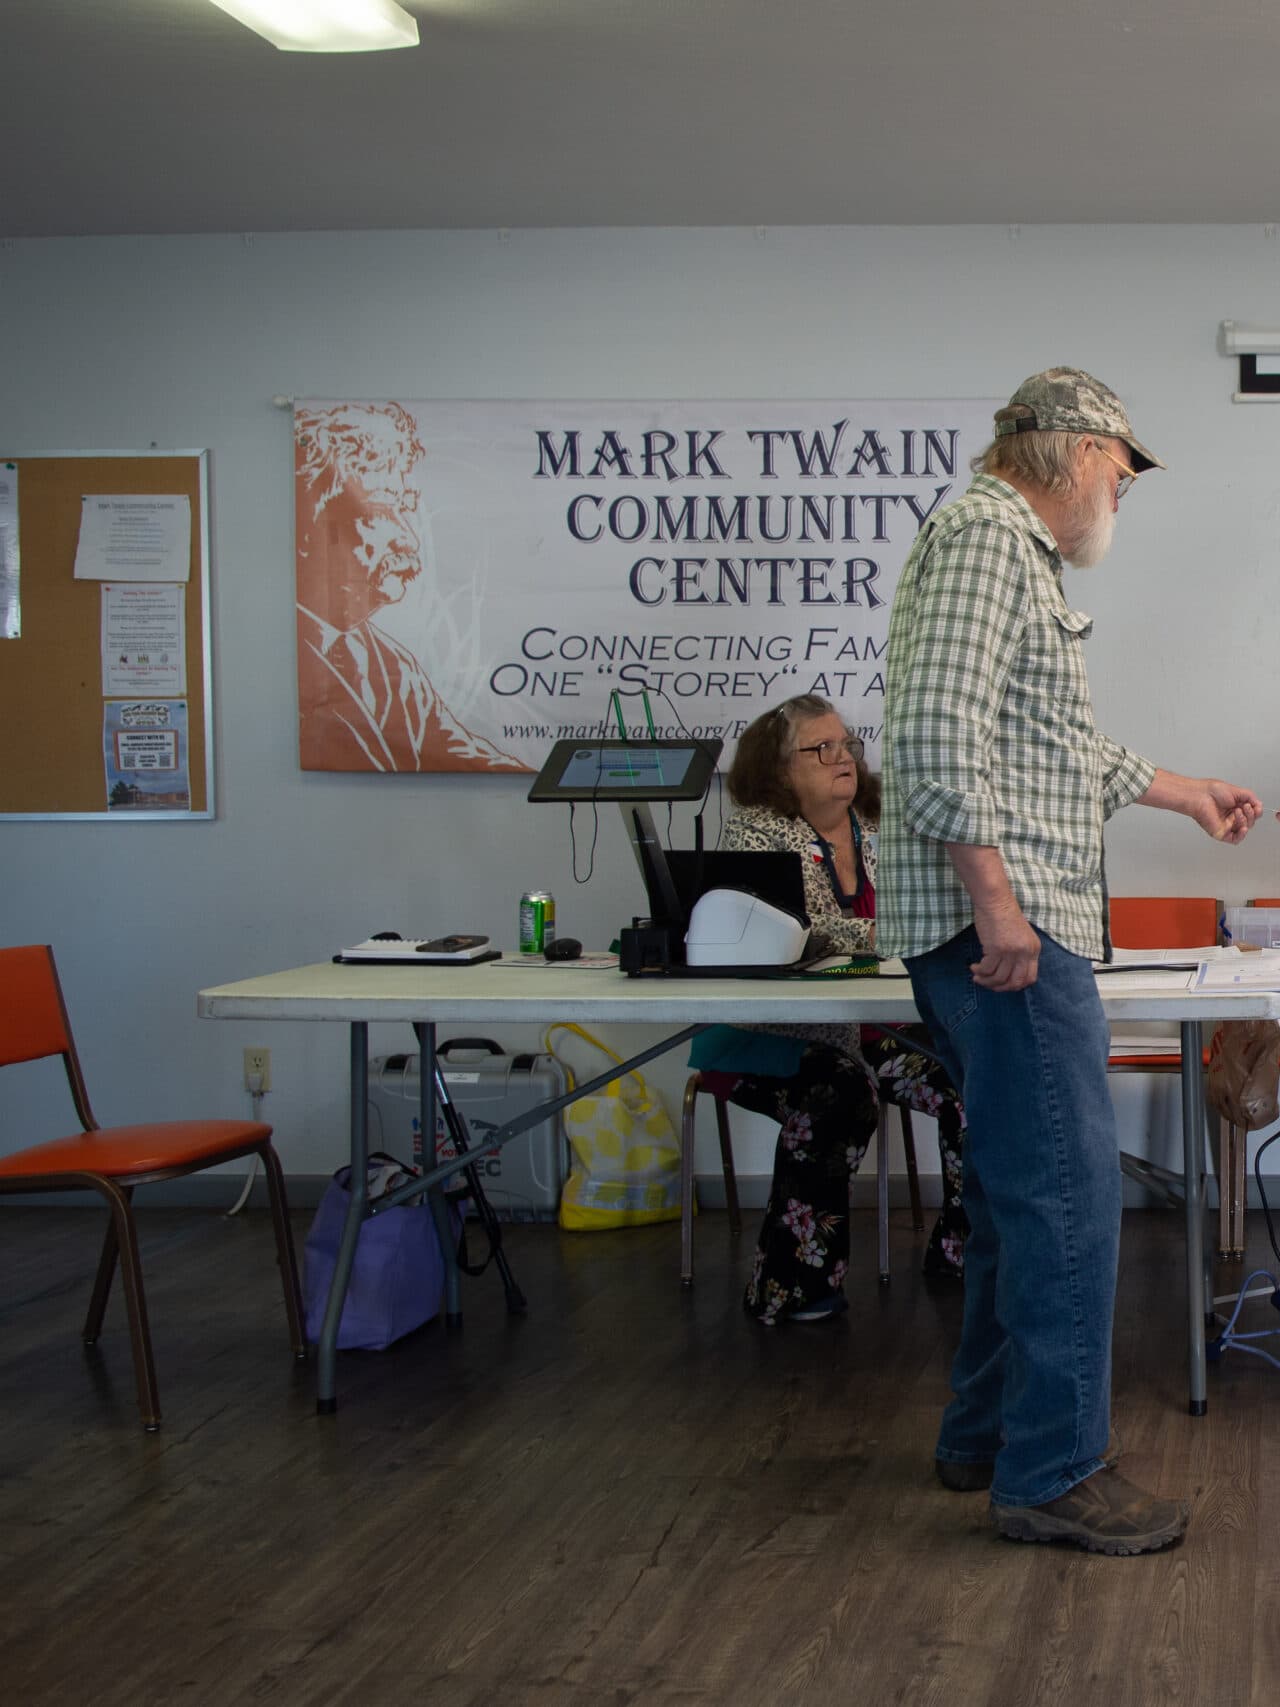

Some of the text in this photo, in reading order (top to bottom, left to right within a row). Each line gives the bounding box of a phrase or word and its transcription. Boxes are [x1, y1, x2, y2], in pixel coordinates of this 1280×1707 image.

[532, 418, 960, 483] MARK TWAIN
[567, 484, 952, 544] COMMUNITY
[629, 557, 888, 609] CENTER
[521, 626, 888, 661] CONNECTING FAM
[490, 663, 584, 697] ONE
[808, 672, 857, 697] AT
[865, 672, 886, 697] A
